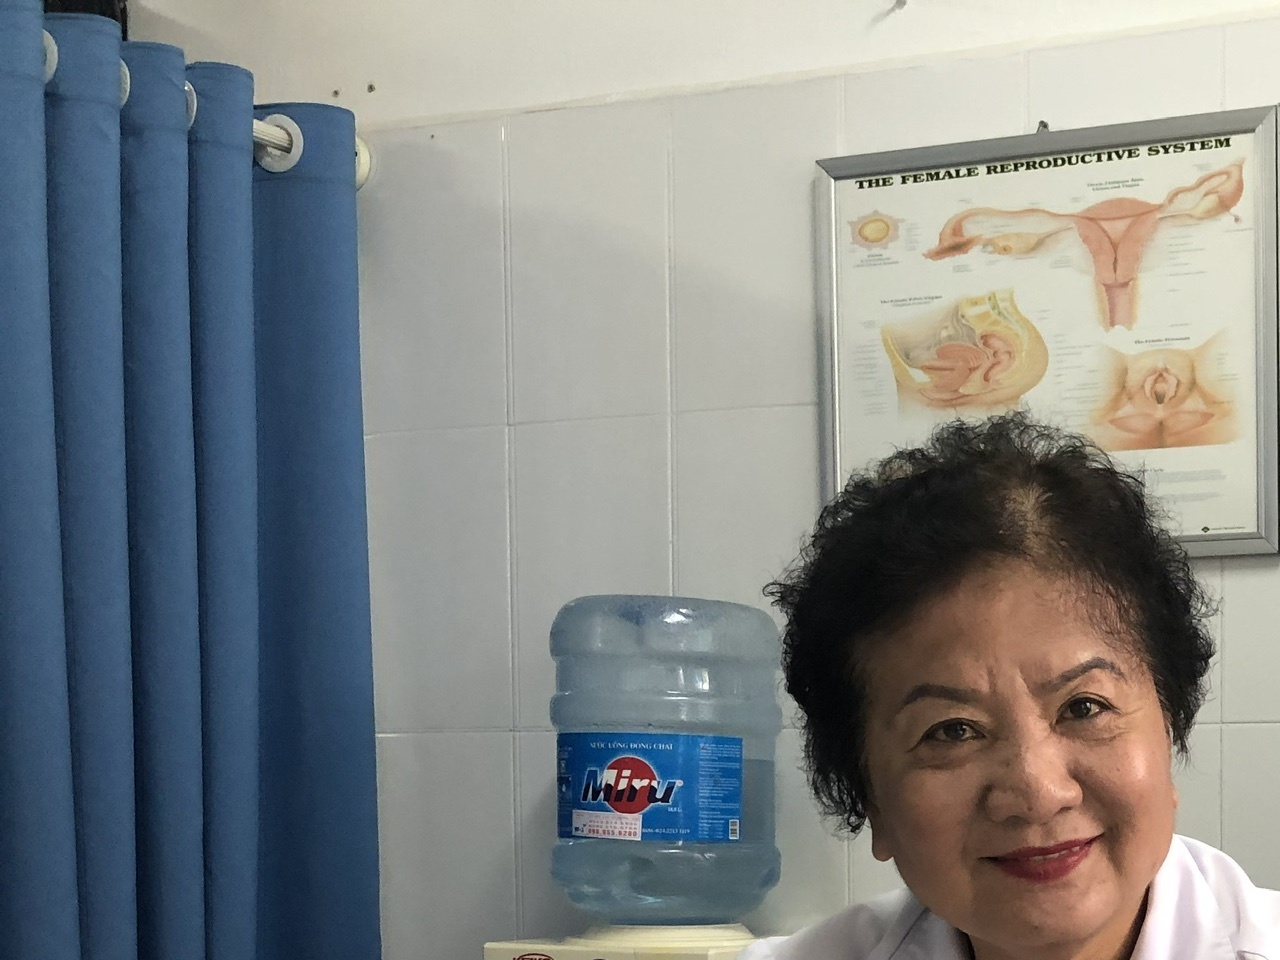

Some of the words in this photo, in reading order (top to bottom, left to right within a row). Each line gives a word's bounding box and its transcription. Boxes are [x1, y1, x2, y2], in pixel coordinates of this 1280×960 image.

[855, 176, 894, 190] THE
[900, 166, 980, 185] FEMALE
[985, 148, 1141, 175] REPRODUCTIVE
[1147, 137, 1232, 157] SYSTEM
[580, 767, 678, 805] Miru
